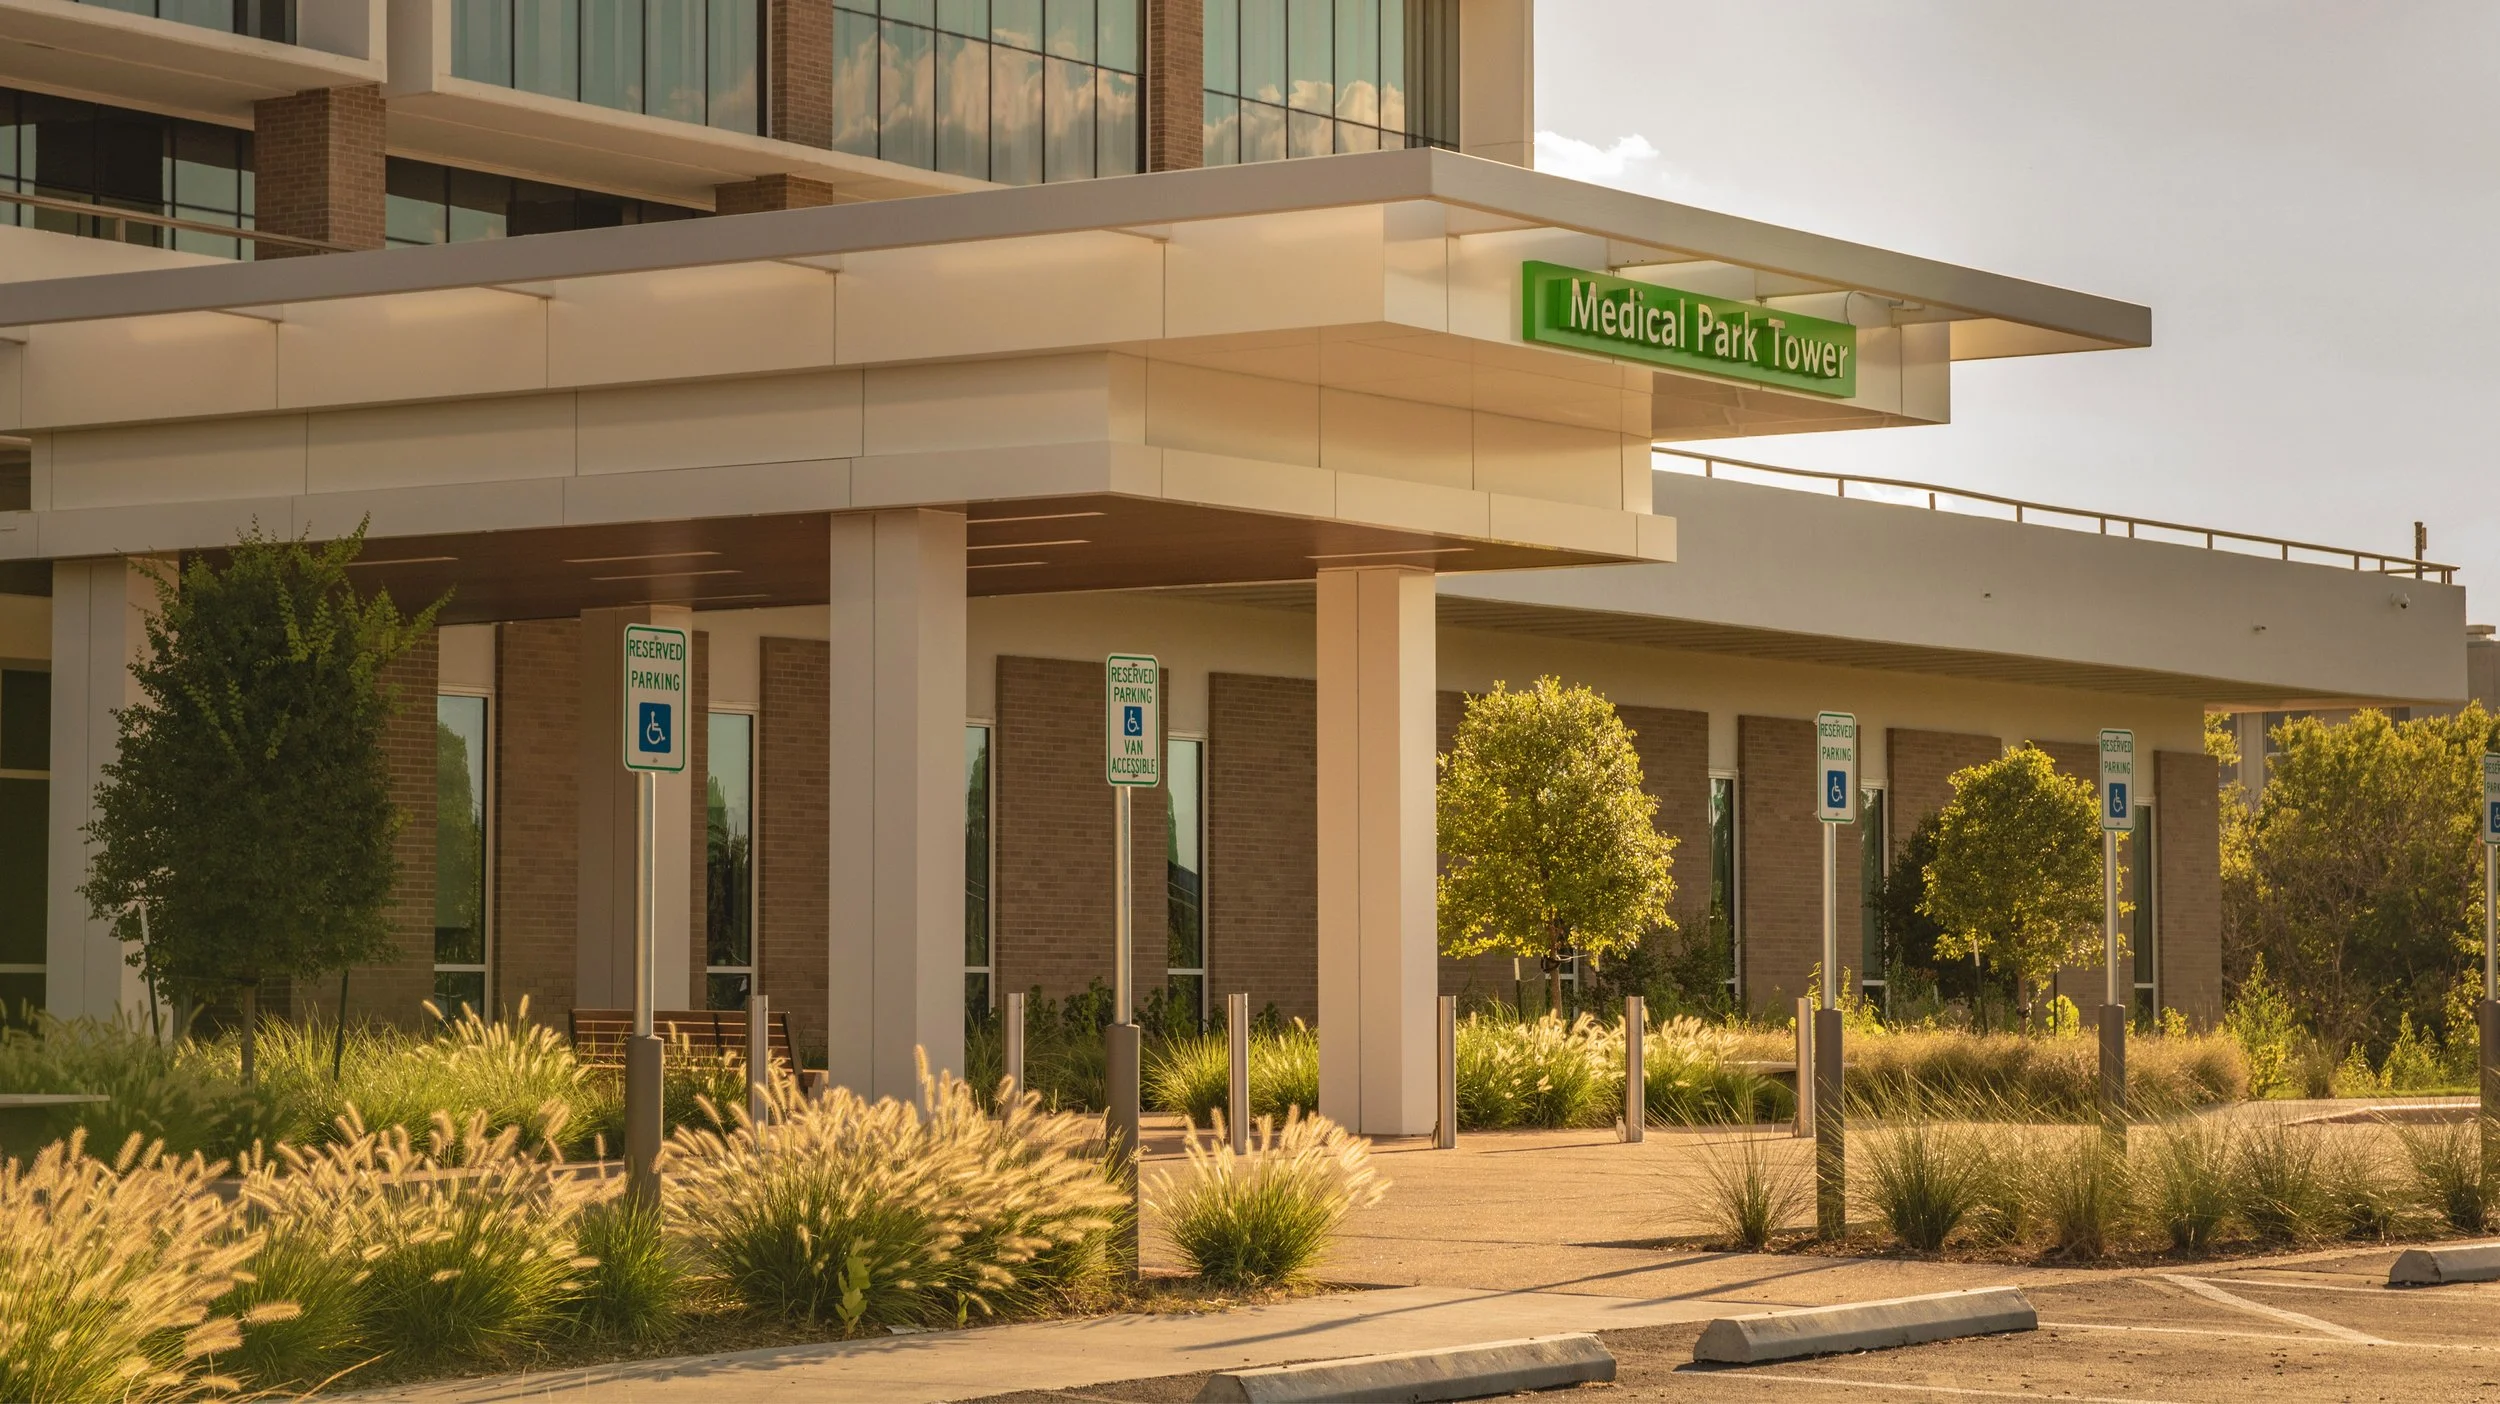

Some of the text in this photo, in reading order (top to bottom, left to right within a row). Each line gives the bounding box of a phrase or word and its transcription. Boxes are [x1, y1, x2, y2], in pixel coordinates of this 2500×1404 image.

[1569, 278, 1848, 378] Medical Park Tower
[629, 639, 683, 661] RESERVED
[631, 670, 680, 691] PARKING
[1111, 667, 1155, 684] RESERVED
[1114, 687, 1152, 704] PARKING
[1821, 723, 1853, 738] RESERVED
[1124, 739, 1143, 755] VAN
[1822, 746, 1852, 761] PARKING
[2102, 740, 2132, 752] RESERVED
[1111, 758, 1155, 774] ACCESSIBLE
[2104, 761, 2130, 774] PARKING
